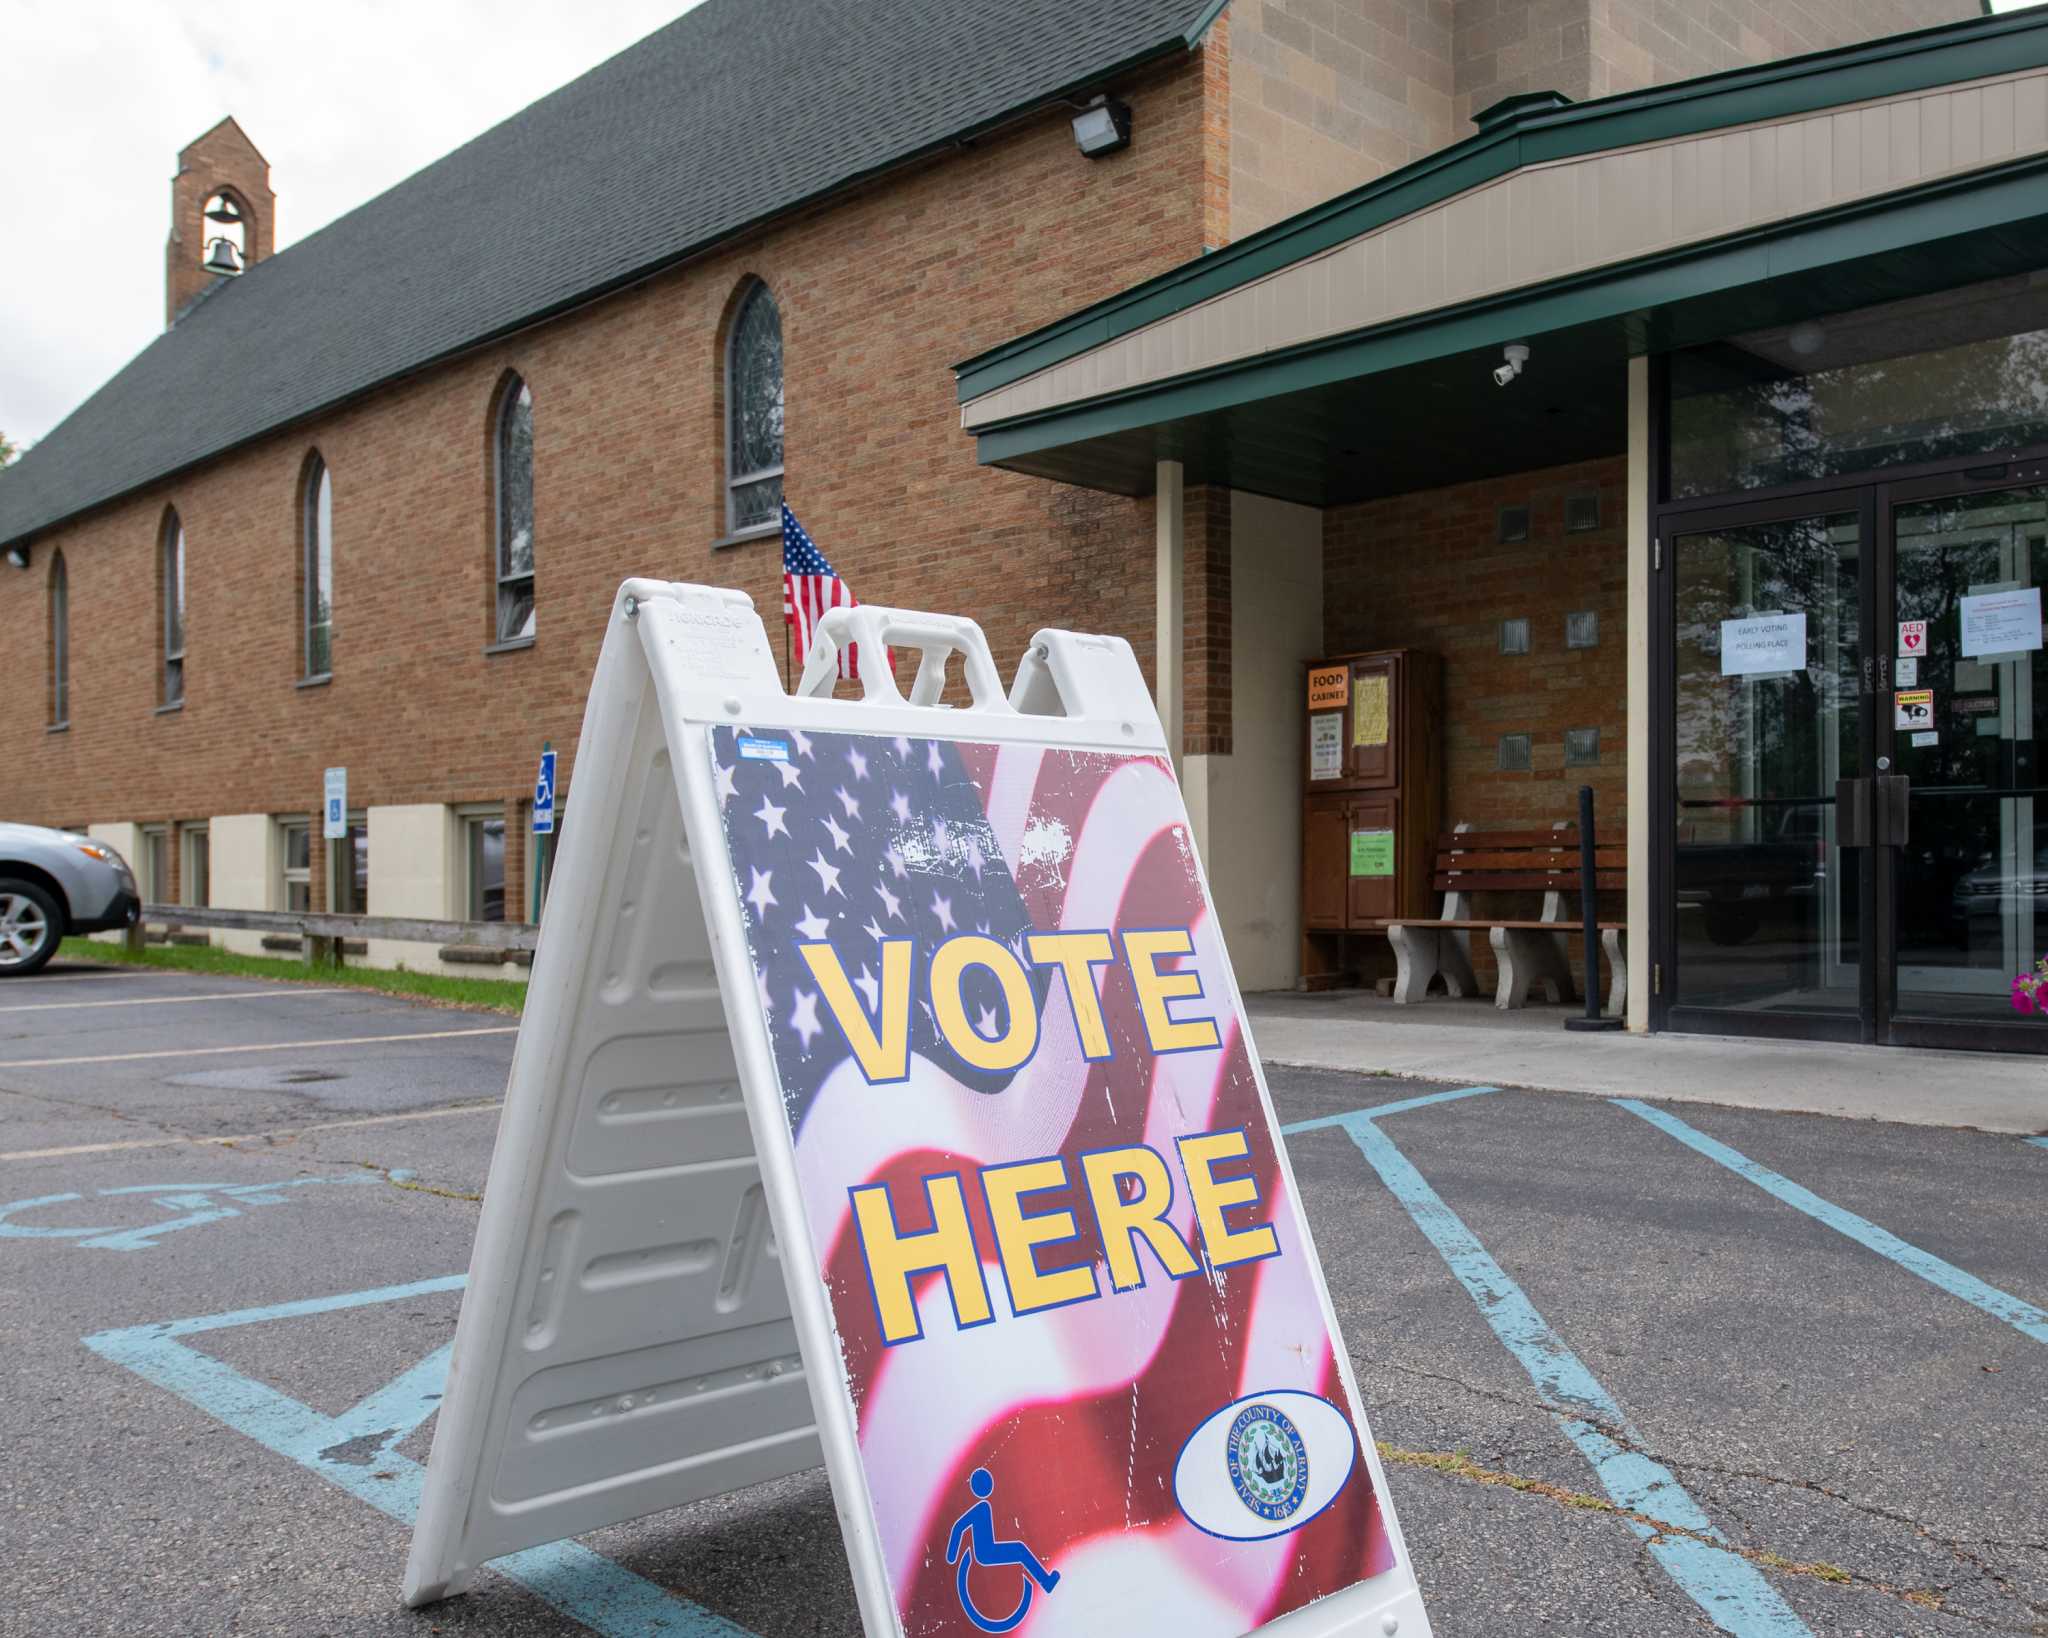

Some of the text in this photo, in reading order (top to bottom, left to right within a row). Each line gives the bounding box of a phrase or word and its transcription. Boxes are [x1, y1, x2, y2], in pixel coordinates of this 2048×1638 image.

[1738, 623, 1788, 636] EARLY VOTING
[1902, 623, 1923, 633] AED
[1736, 639, 1789, 651] POLLING PLACE
[1313, 674, 1343, 688] FOOD
[1312, 690, 1345, 702] CABINET
[1899, 694, 1929, 702] WARNING
[792, 927, 1223, 1085] VOTE
[847, 1126, 1282, 1348] HERE
[1230, 1407, 1306, 1512] SEAL OF THE COUNTY OF ALBANY
